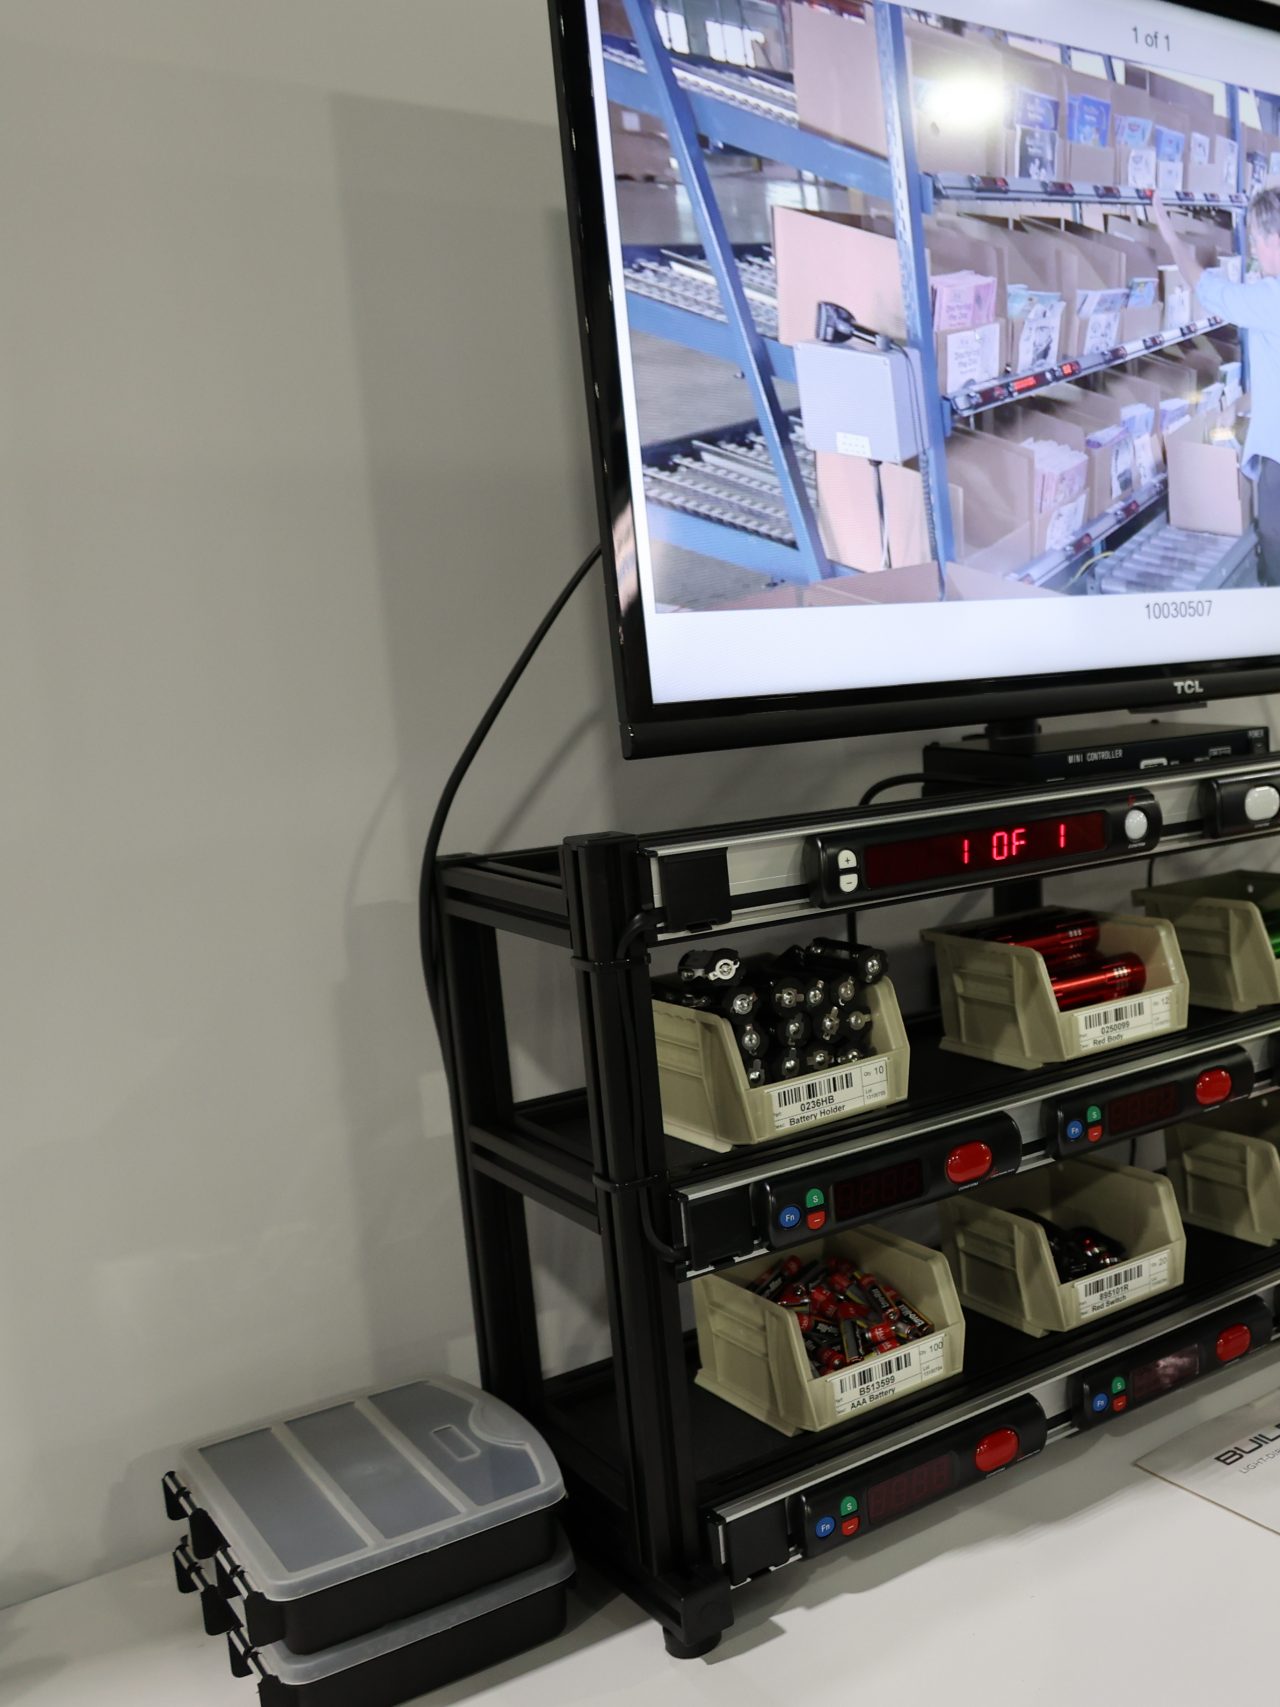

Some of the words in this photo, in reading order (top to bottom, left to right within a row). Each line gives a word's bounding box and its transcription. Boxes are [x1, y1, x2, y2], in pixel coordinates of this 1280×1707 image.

[1132, 26, 1138, 44] 1
[1144, 31, 1159, 49] of
[1164, 34, 1170, 52] 1
[1145, 600, 1213, 620] 10030507
[1173, 680, 1204, 695] TCL
[1067, 752, 1084, 765] MINI
[1086, 749, 1123, 763] CONTROLLER
[963, 838, 969, 865] 1
[992, 828, 1027, 861] OF
[1060, 823, 1066, 848] 1
[1101, 1021, 1130, 1035] 0250099
[1093, 1038, 1105, 1046] Red
[1108, 1034, 1123, 1045] Body
[874, 1065, 884, 1075] 10
[800, 1095, 834, 1112] 0236HB
[789, 1113, 818, 1127] Battery
[820, 1104, 846, 1117] Holder
[1100, 1284, 1129, 1300] 895101R
[1092, 1303, 1104, 1312] Red
[1106, 1295, 1127, 1308] Switch
[929, 1341, 944, 1352] 100
[859, 1376, 895, 1396] B513599
[850, 1398, 867, 1410] AAA
[869, 1387, 896, 1403] Battery
